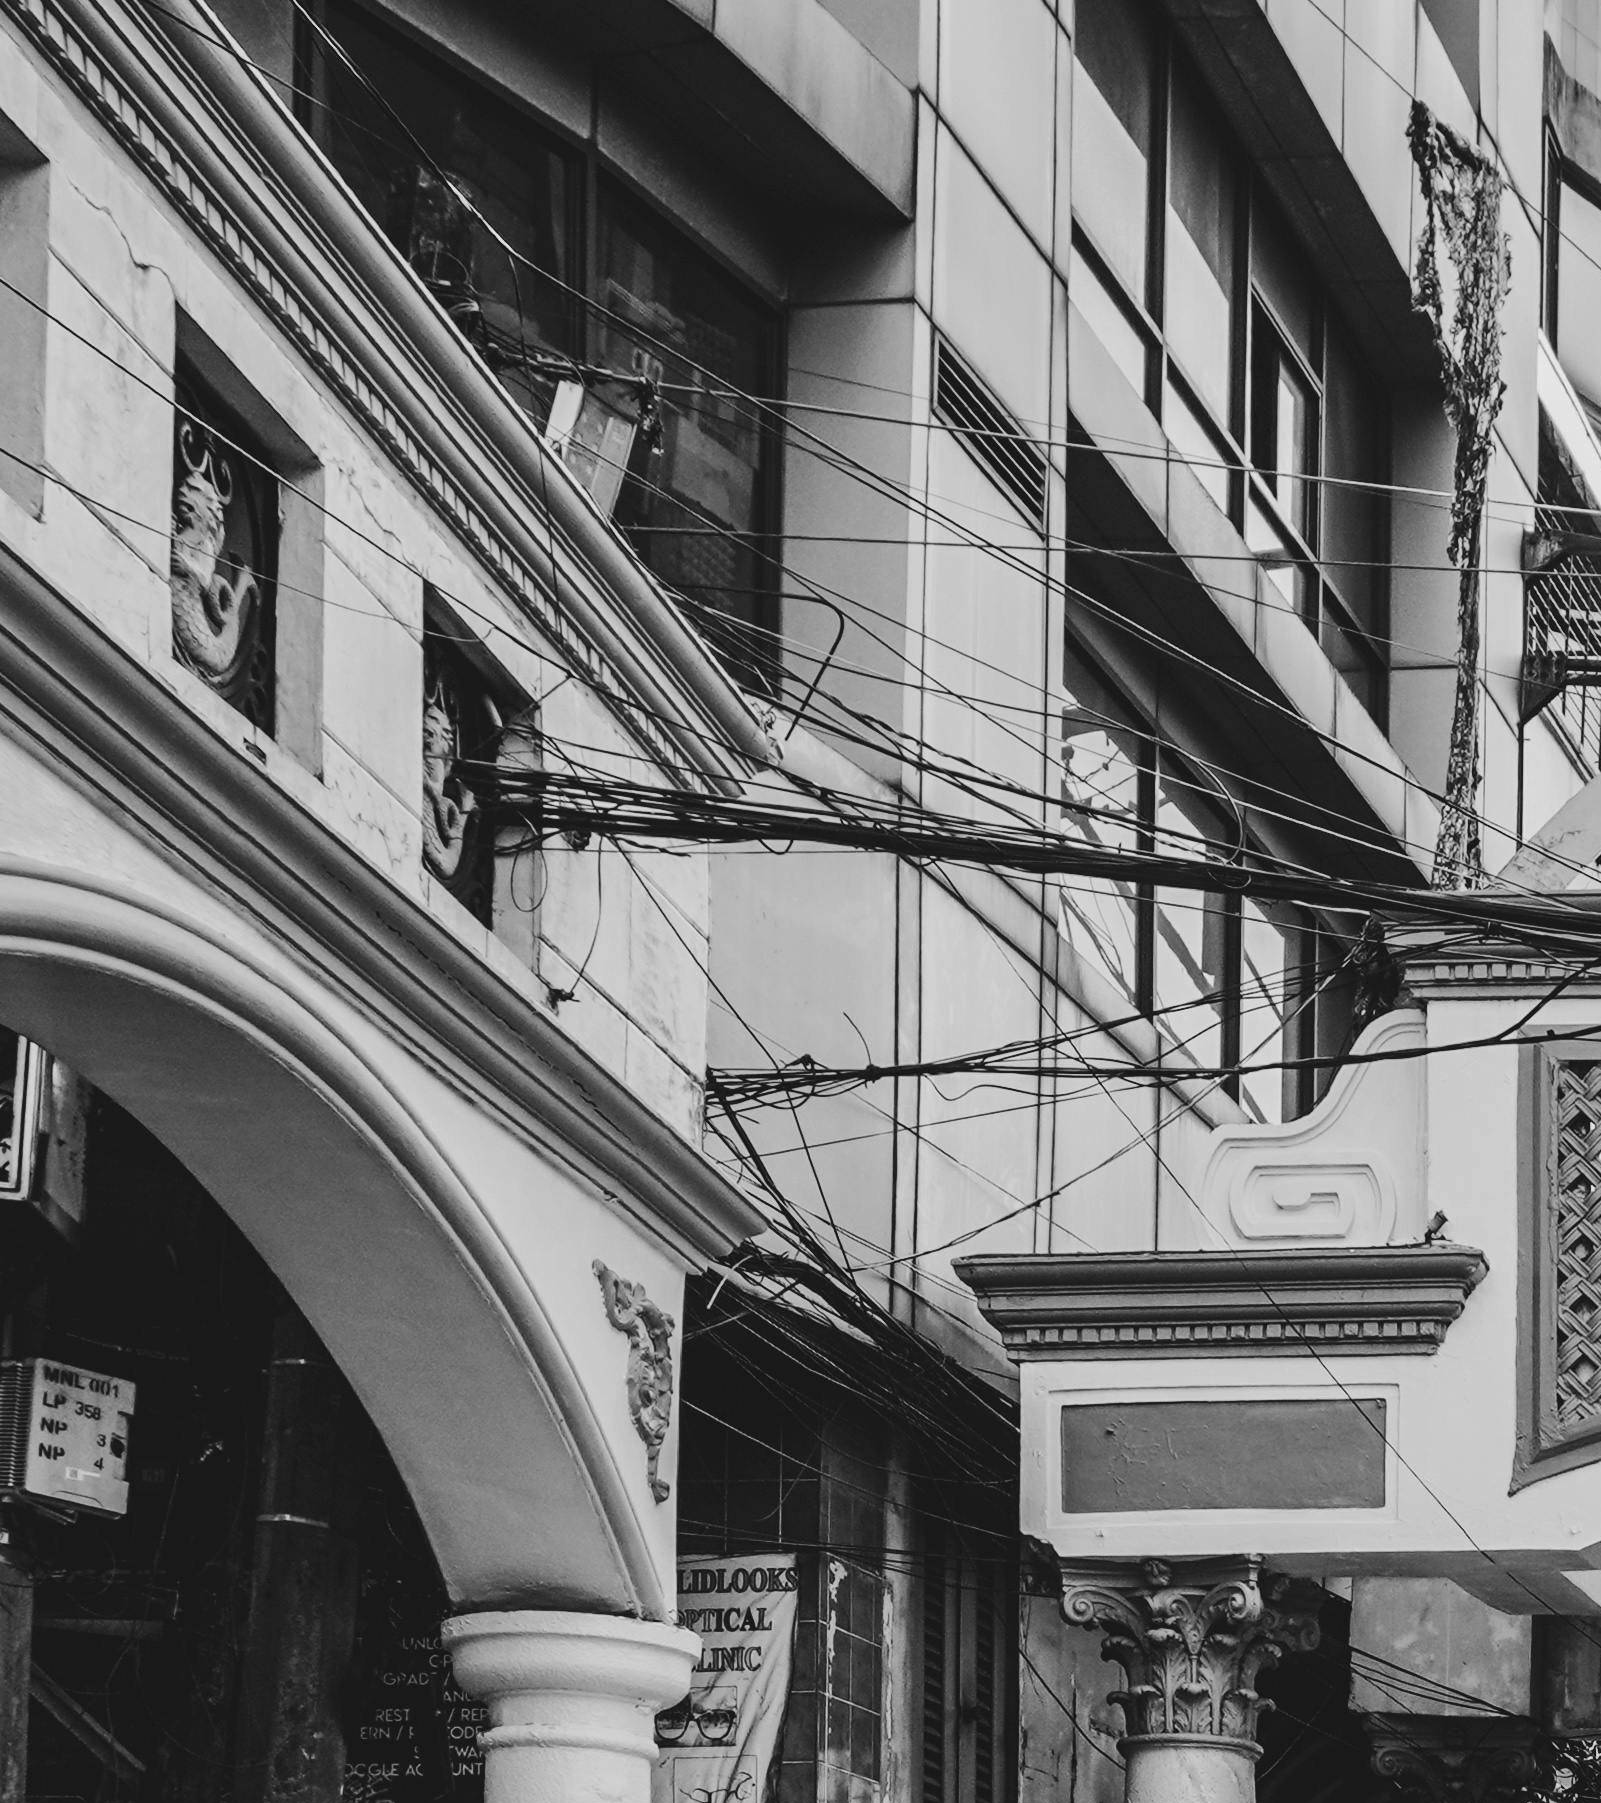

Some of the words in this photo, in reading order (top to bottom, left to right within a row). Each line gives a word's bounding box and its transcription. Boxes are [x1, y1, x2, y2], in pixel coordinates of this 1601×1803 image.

[88, 1378, 119, 1398] 001
[74, 1401, 102, 1420] 358
[96, 1433, 107, 1448] 3
[93, 1457, 105, 1471] 4
[691, 1646, 762, 1672] LINIC
